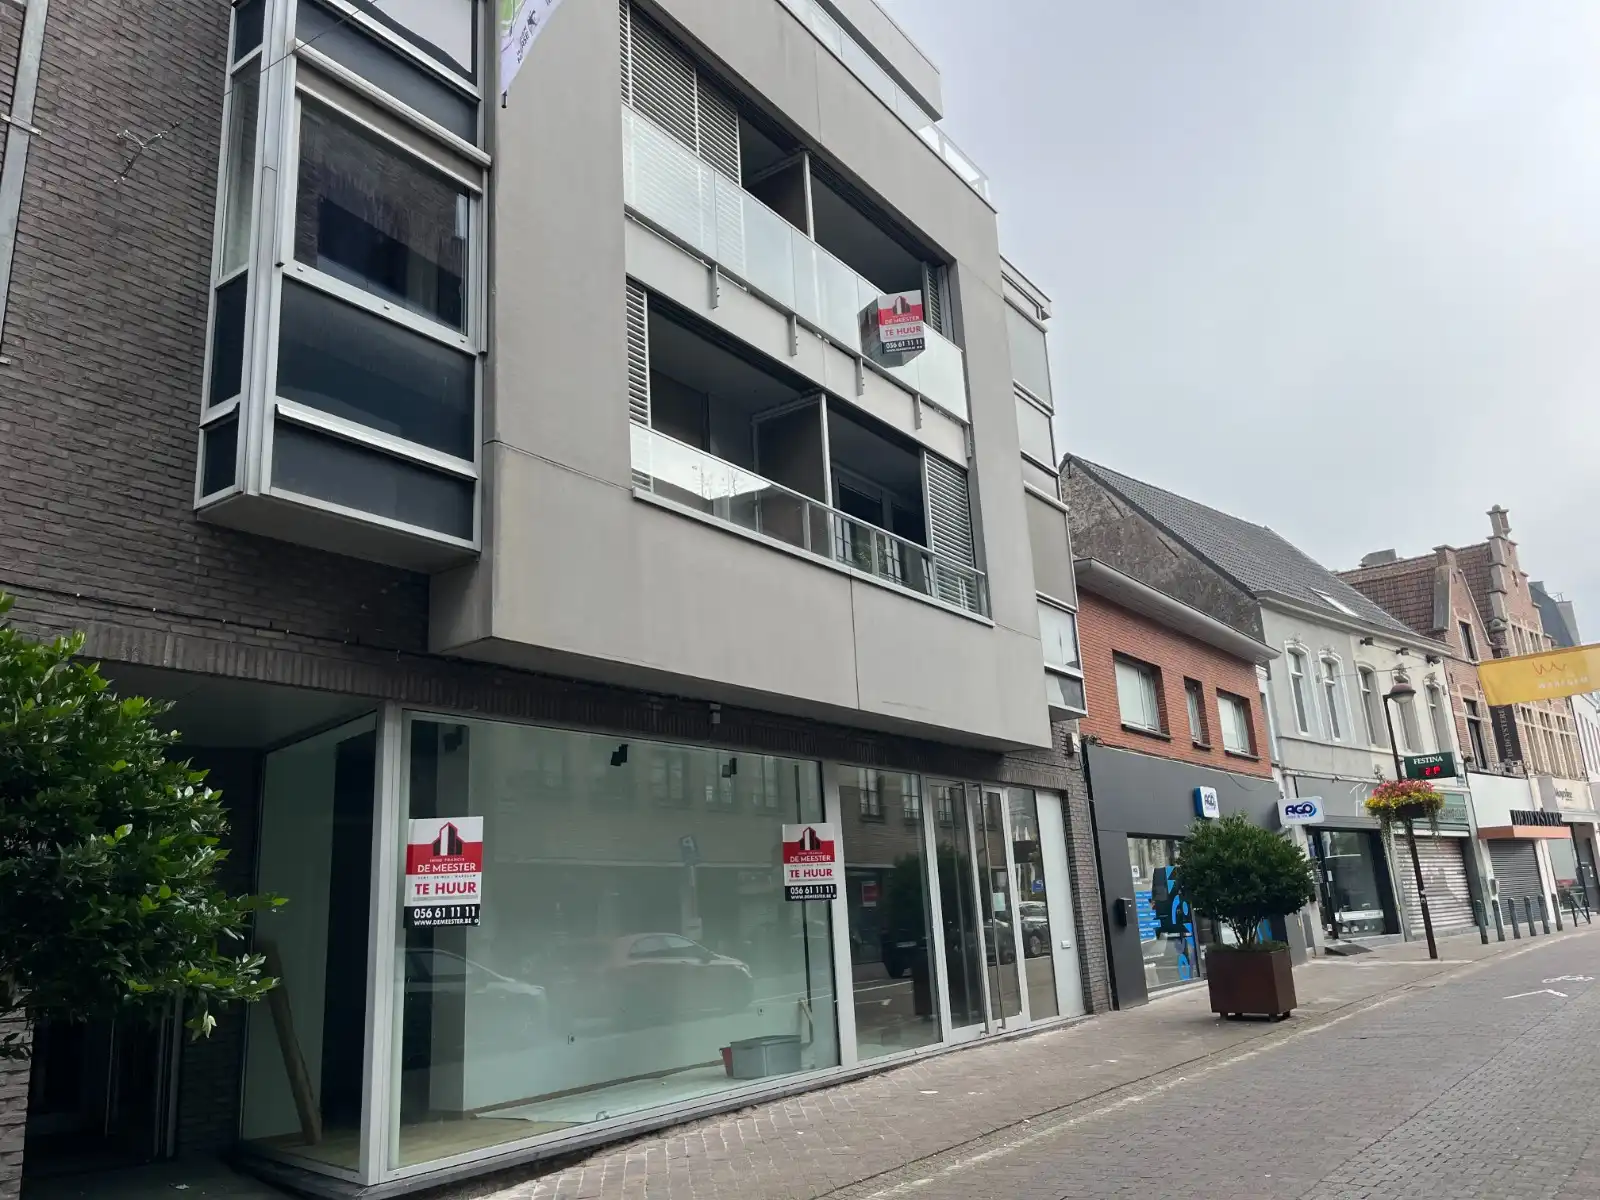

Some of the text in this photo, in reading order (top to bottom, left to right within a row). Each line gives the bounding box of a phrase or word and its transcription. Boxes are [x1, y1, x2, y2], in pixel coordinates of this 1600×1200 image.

[896, 326, 921, 335] HUUR
[1413, 756, 1443, 765] FESTINA
[1285, 803, 1315, 815] AGO
[800, 854, 831, 862] MEESTER
[417, 862, 476, 873] DE MEESTER
[789, 868, 833, 878] TE HUUR
[415, 881, 477, 895] TE HUUR
[790, 885, 834, 895] 056 61 11 11
[413, 906, 476, 919] 056 61 11 11
[413, 918, 472, 926] WWW.DEMEESTER.BE
